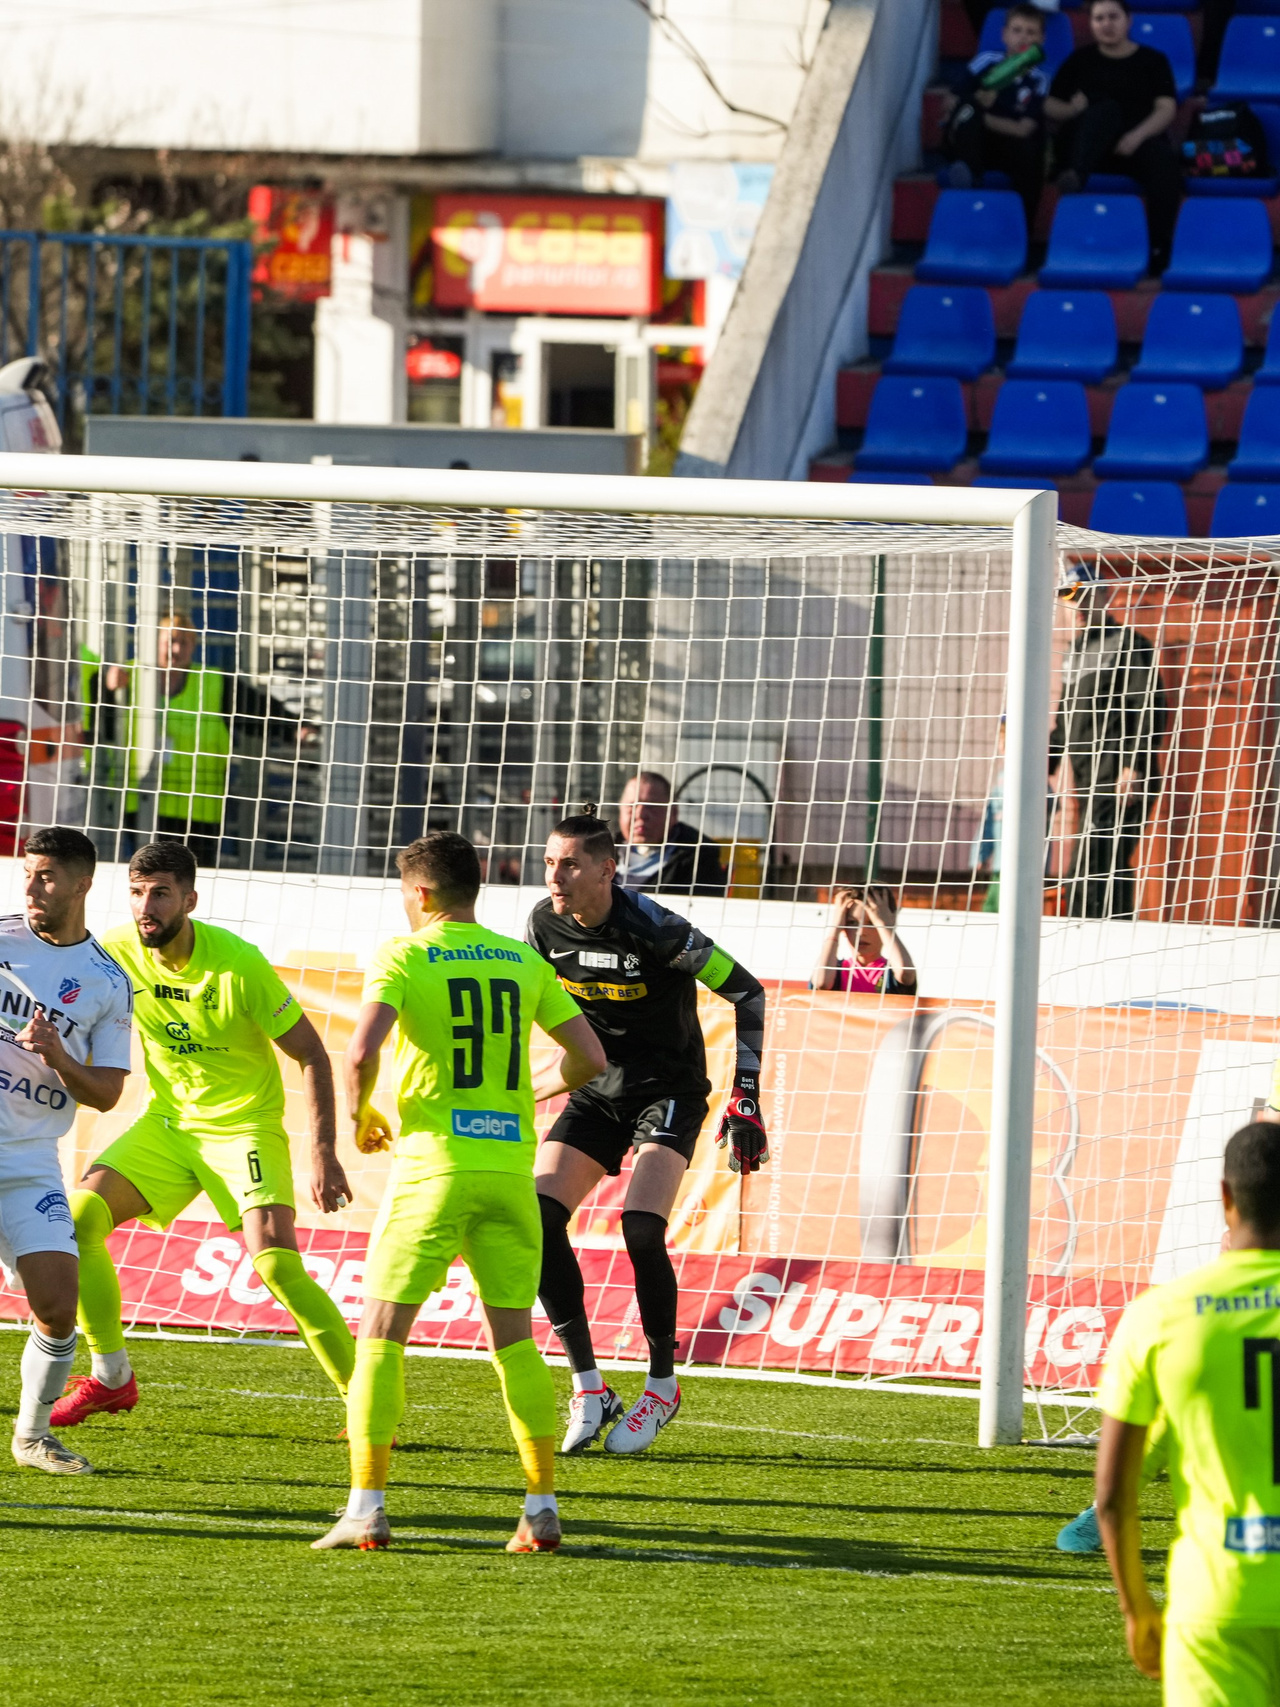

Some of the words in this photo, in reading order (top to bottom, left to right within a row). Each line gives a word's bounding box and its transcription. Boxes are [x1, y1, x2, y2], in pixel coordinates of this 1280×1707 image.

[508, 212, 643, 265] casa
[427, 944, 524, 963] Panifcom
[579, 951, 618, 969] IASI
[702, 967, 719, 983] SPECT
[618, 987, 641, 998] BET
[447, 977, 521, 1091] 37
[455, 1115, 517, 1137] Leier
[247, 1151, 261, 1184] 6
[719, 1271, 1108, 1368] SUPERIG
